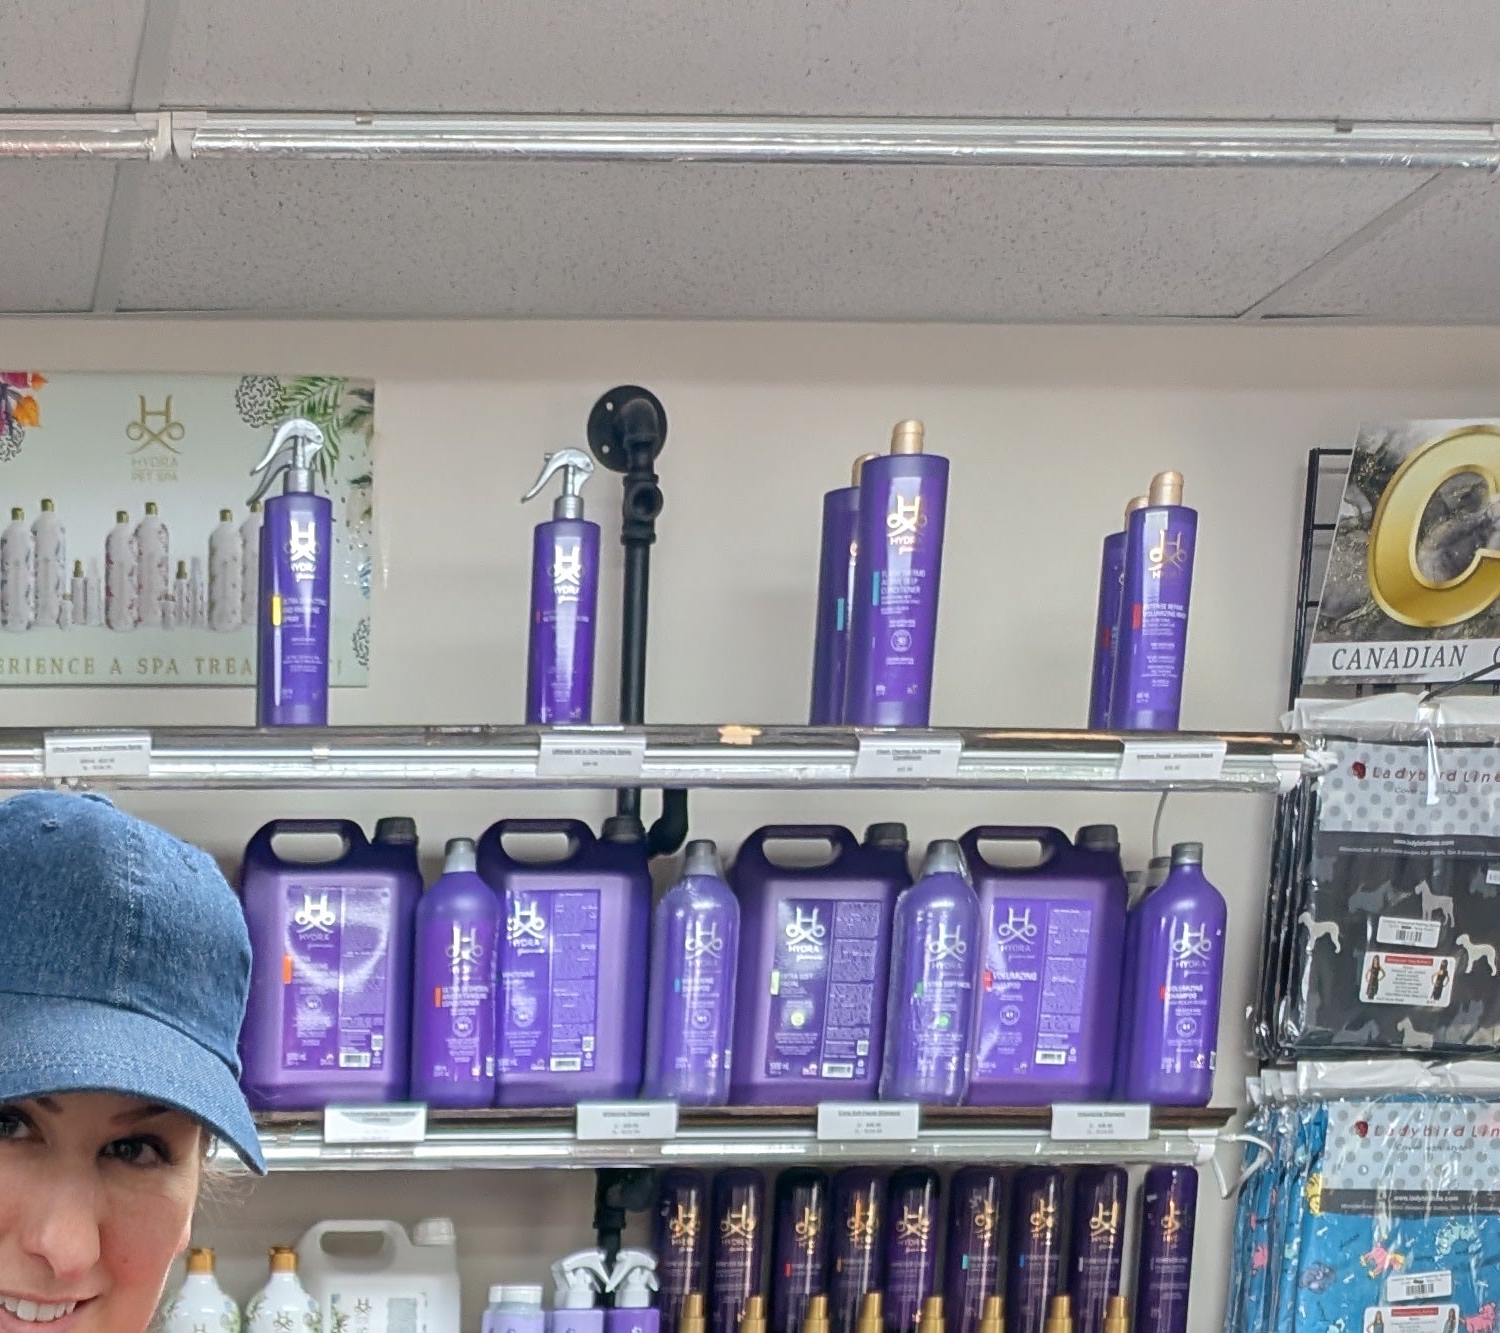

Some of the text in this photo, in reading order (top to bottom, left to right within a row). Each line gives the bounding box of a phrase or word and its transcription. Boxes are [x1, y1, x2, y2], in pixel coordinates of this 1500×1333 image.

[131, 471, 179, 482] PET SPA
[1331, 645, 1469, 671] CANADIAN
[110, 658, 123, 675] A
[137, 658, 180, 675] SPA
[1372, 765, 1458, 783] Ladybrd
[787, 943, 820, 953] HYDRA
[1374, 1124, 1500, 1139] Ladybird Lin
